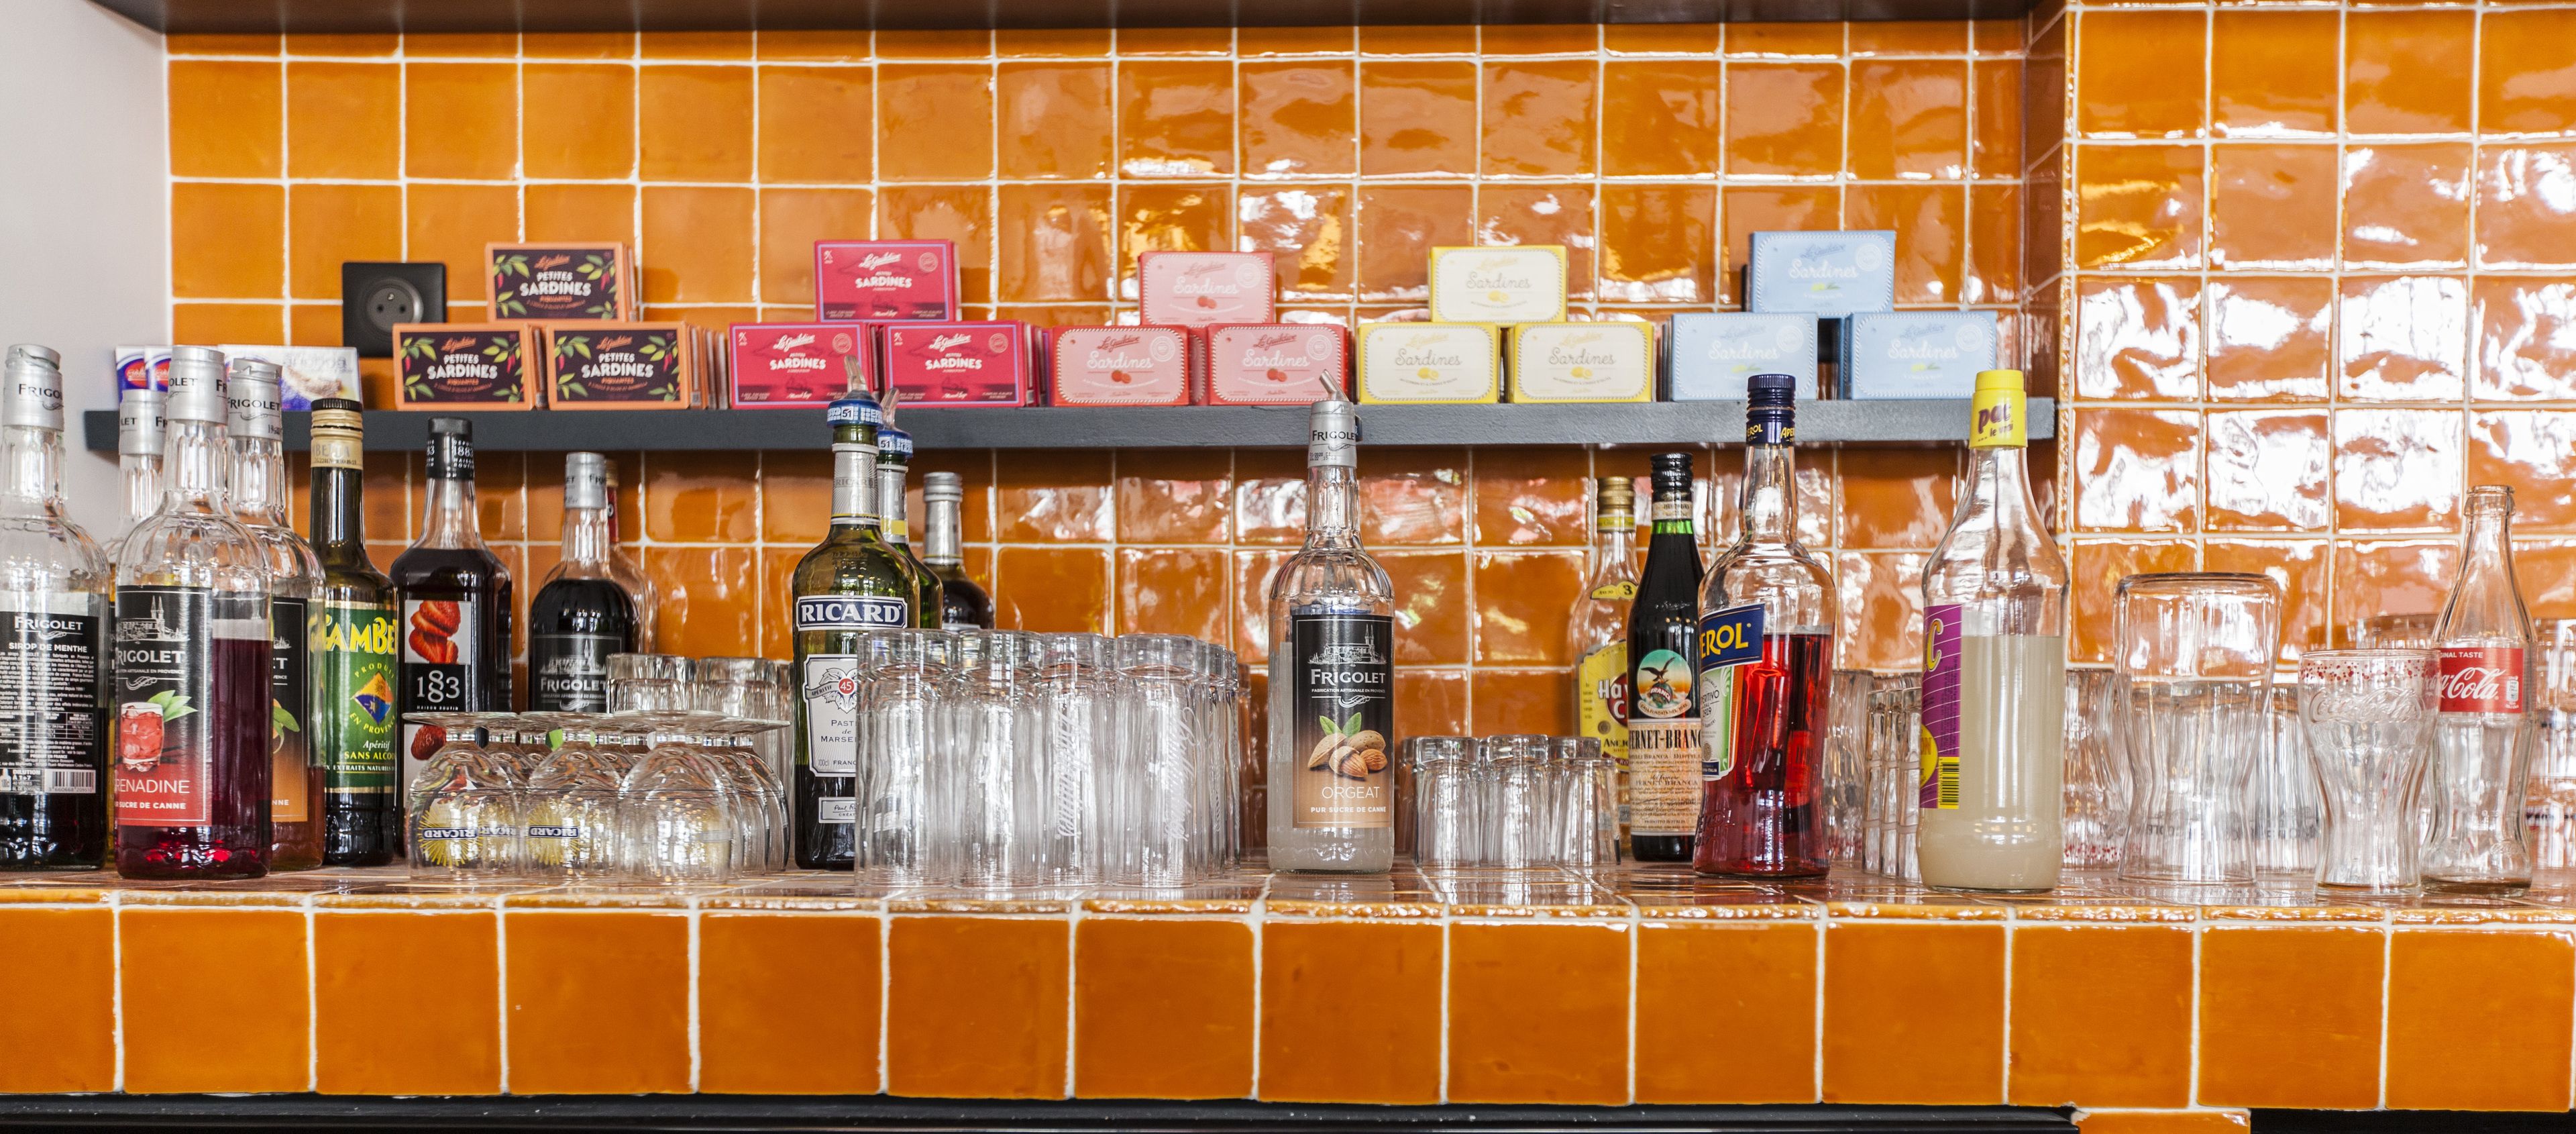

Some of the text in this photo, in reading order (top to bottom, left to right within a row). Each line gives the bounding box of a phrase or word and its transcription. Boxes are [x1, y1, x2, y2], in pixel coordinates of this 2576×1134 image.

[1789, 258, 1858, 278] Sardines
[537, 270, 573, 282] PETITES
[855, 276, 912, 289] SARDINES
[1466, 271, 1532, 289] Sardines
[519, 280, 592, 297] SARDINES
[1173, 276, 1240, 295] Sardines
[1549, 347, 1616, 365] Sardines
[1708, 340, 1780, 360] Sardines
[1888, 339, 1960, 359] Sardines
[443, 354, 479, 364] PETITES
[598, 352, 635, 363] PETITES
[769, 358, 826, 370] SARDINES
[925, 358, 983, 370] SARDINES
[1087, 350, 1154, 368] Sardines
[1242, 349, 1310, 367] Sardines
[1395, 348, 1462, 366] Sardines
[427, 364, 498, 380] SARDINES
[581, 362, 654, 378] SARDINES
[169, 378, 198, 386] OLET
[19, 384, 62, 400] FRIGO
[843, 409, 852, 417] 51
[1312, 430, 1354, 442] FRIGOLE
[1747, 424, 1763, 437] EROL
[1780, 427, 1794, 438] APE
[1623, 584, 1632, 595] 3
[801, 603, 902, 623] RICARD
[15, 616, 83, 631] FRIGOLET
[9, 642, 37, 650] SIROP
[54, 644, 88, 653] MENTHE
[1701, 622, 1749, 659] EROL
[118, 650, 185, 665] RIGOLET
[354, 662, 395, 678] PRODUIT
[1311, 669, 1386, 686] FRIGOLET
[541, 676, 606, 692] FRIGOLET
[811, 685, 833, 697] APÉRITIF
[841, 682, 852, 690] 45
[1650, 688, 1671, 703] BRANCA
[350, 713, 396, 735] EN PROVENC
[363, 739, 391, 750] Apéritif
[344, 752, 396, 761] SANS ALCOO
[116, 779, 191, 794] RENADINE
[1322, 786, 1381, 799] ORGEAT
[153, 802, 186, 810] CANNE
[424, 828, 476, 838] RICARD
[531, 827, 578, 837] RICARD
